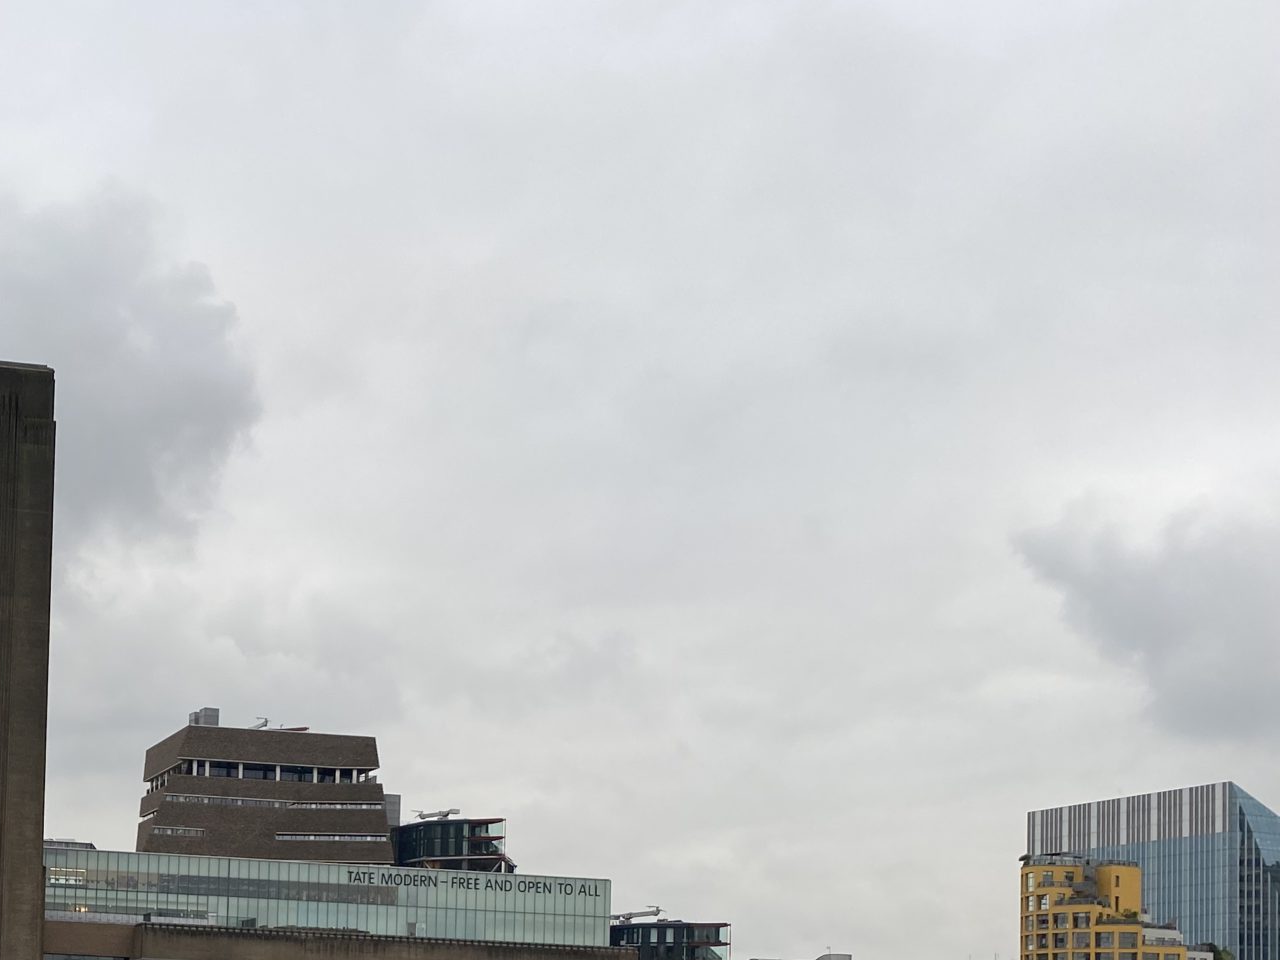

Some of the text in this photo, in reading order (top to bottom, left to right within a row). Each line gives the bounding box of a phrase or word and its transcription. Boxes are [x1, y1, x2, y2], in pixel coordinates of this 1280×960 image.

[347, 871, 375, 885] TATE
[380, 873, 437, 888] MODERN
[451, 876, 480, 890] FREE
[484, 878, 513, 892] AND
[517, 880, 552, 894] OPEN
[558, 883, 574, 896] TO
[577, 884, 601, 897] ALL
